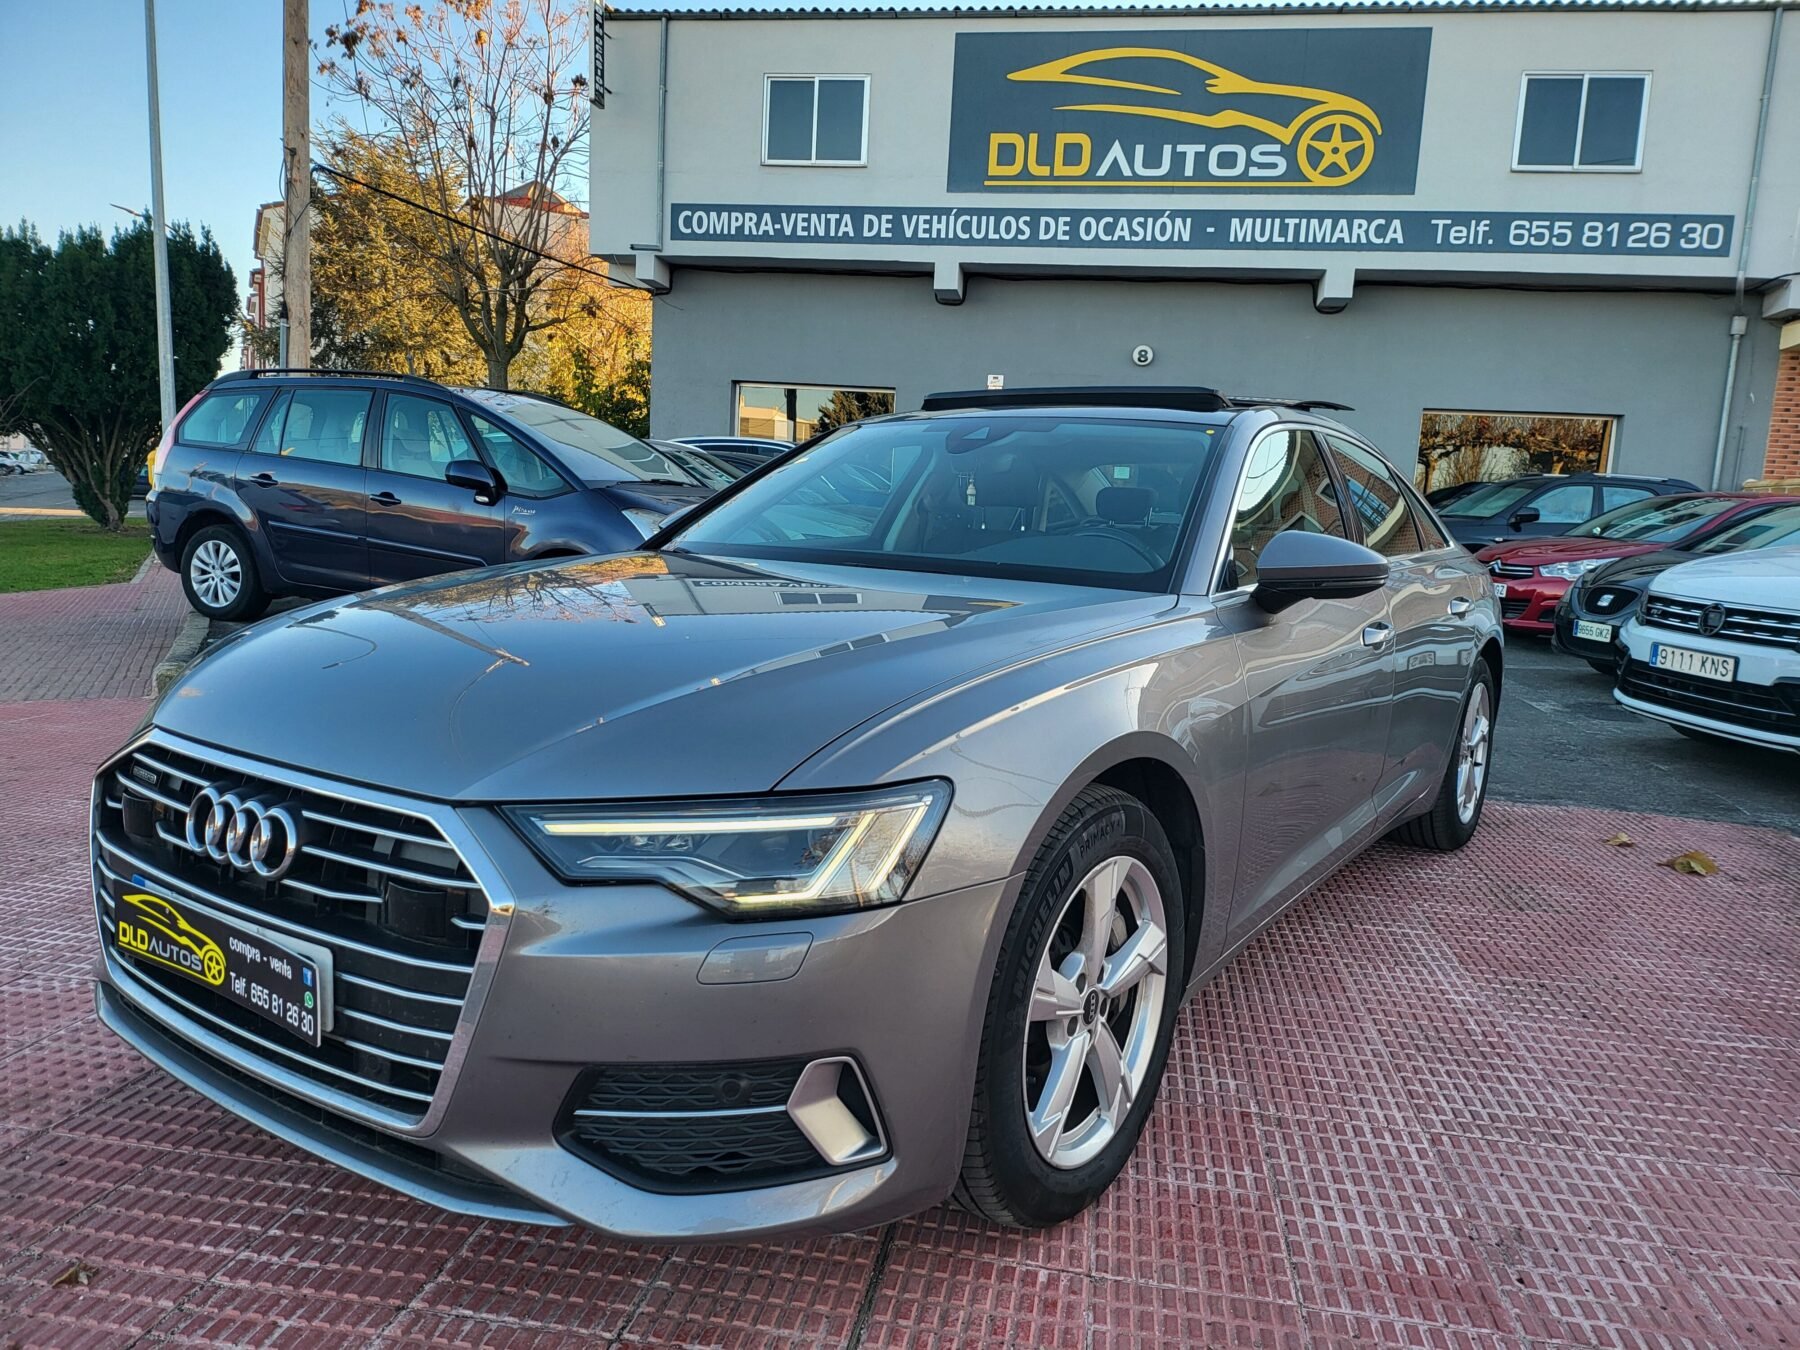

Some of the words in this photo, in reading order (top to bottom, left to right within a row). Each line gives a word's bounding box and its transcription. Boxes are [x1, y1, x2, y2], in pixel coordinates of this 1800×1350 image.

[988, 132, 1092, 176] DLD
[1095, 139, 1288, 177] AUTOS
[678, 210, 854, 238] COMPRA-VENTA
[863, 213, 893, 238] DE
[902, 208, 1031, 241] VEHÍCULOS
[1038, 216, 1071, 241] DE
[1079, 210, 1191, 242] OCASIÓN
[1229, 217, 1405, 244] MULTIMARCA
[1430, 219, 1494, 245] Telf.
[1508, 220, 1573, 247] 655
[1679, 223, 1724, 250] 30
[1137, 349, 1149, 363] 8
[1578, 624, 1594, 636] 9655
[1595, 627, 1610, 639] GKZ
[1659, 648, 1694, 671] 9111
[1700, 656, 1730, 678] KNS
[119, 920, 149, 951] DLD
[149, 936, 202, 971] AUTOS
[1013, 858, 1073, 998] MICHELIN
[229, 936, 261, 964] compra
[269, 956, 292, 980] venta
[230, 971, 248, 998] Telf.
[251, 982, 270, 1010] 655
[272, 994, 283, 1018] 81
[286, 1002, 299, 1027] 26
[301, 1010, 314, 1036] 30
